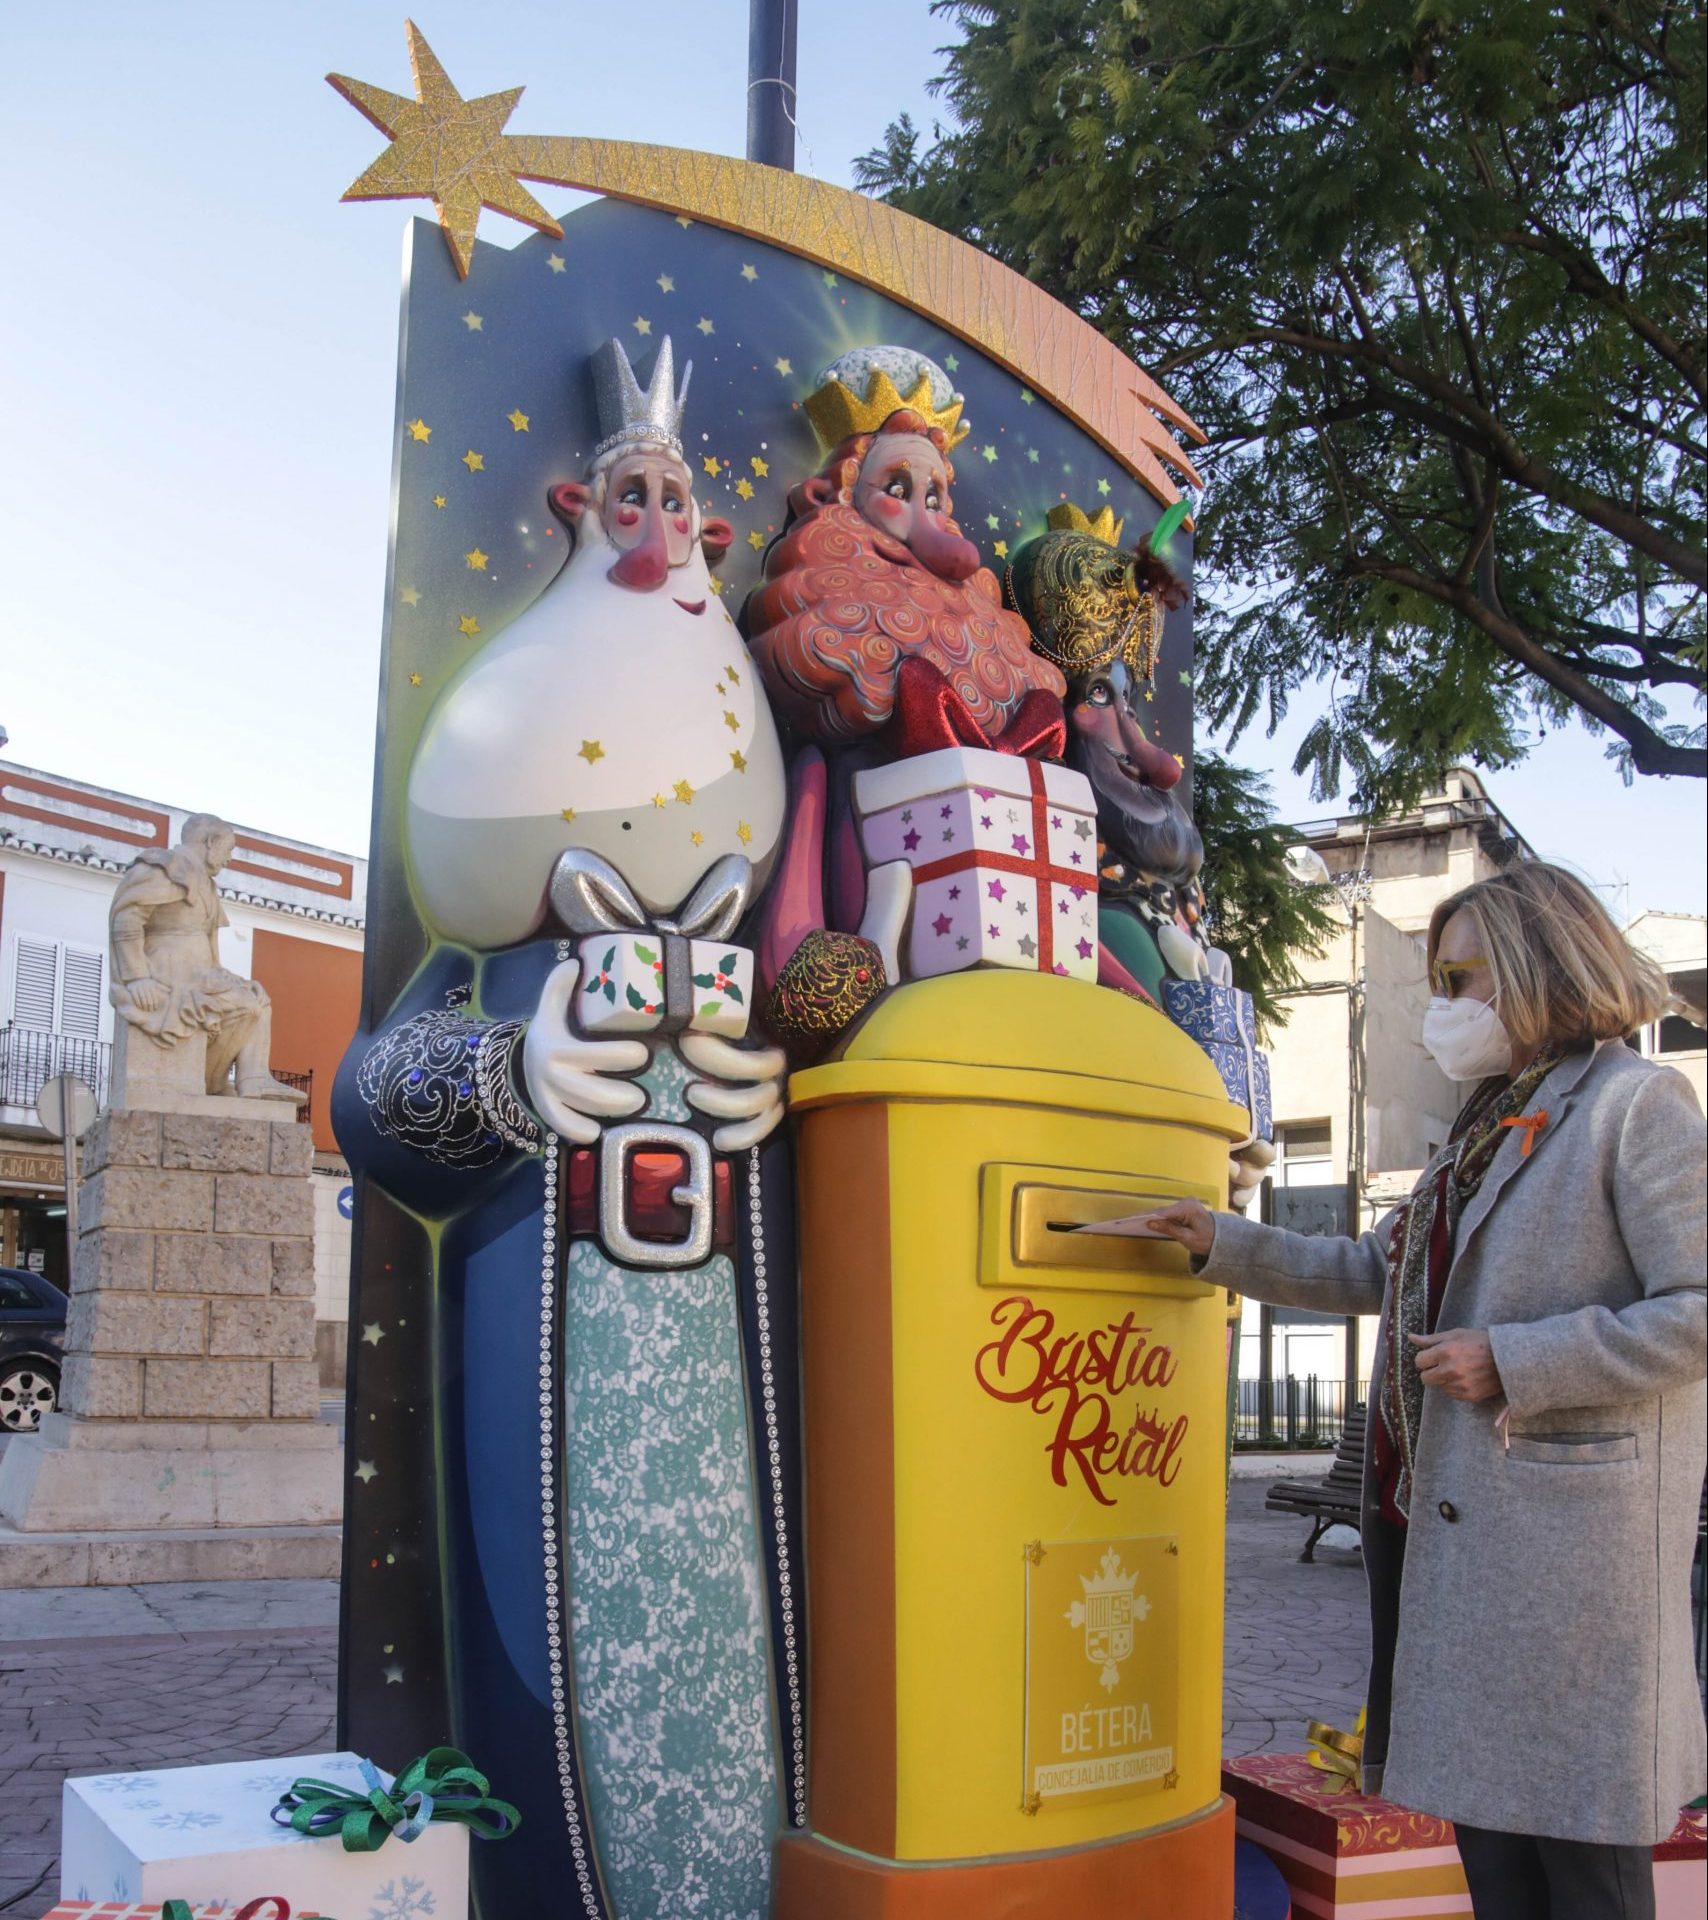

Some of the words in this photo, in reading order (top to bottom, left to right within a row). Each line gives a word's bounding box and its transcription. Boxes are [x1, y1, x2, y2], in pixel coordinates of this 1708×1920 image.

[1031, 1380, 1188, 1505] Reial
[1061, 1702, 1153, 1754] BÉTERA
[1107, 1762, 1121, 1782] DE
[1123, 1751, 1170, 1779] COMERCIO
